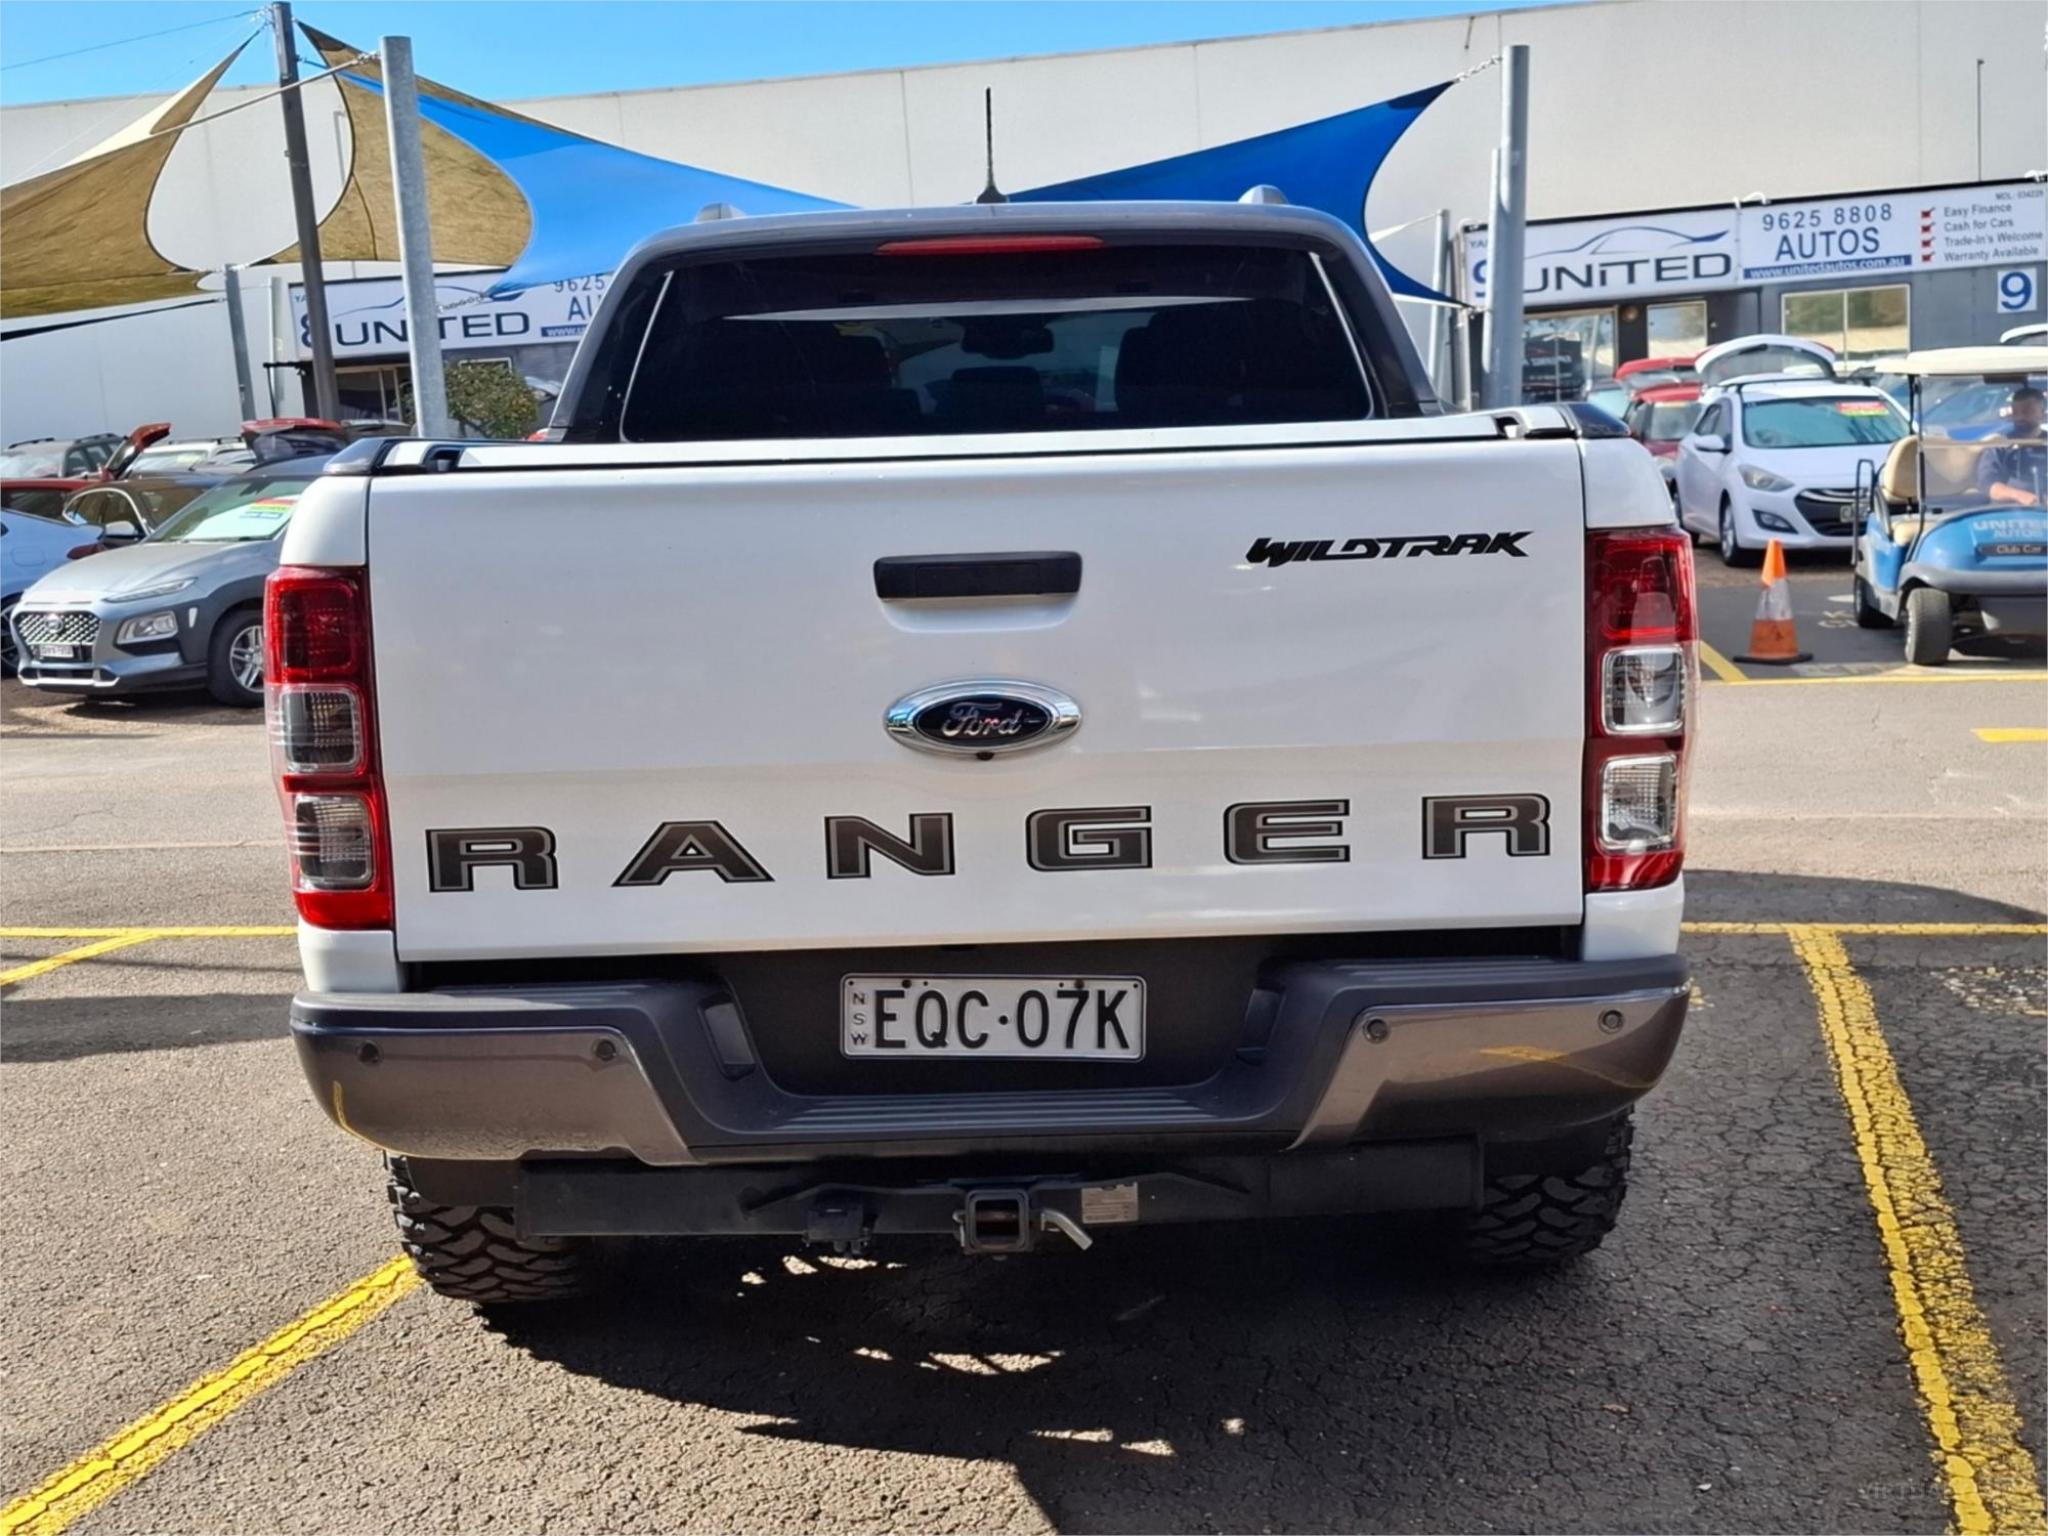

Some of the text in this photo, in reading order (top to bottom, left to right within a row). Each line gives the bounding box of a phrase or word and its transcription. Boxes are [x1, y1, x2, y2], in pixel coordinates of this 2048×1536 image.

[1762, 203, 1892, 231] 9625 8808
[1944, 202, 2012, 218] Easy Finance
[1944, 217, 2014, 232] Cash for Cars
[1775, 226, 1881, 262] AUTOS
[1997, 231, 2043, 243] Welcome
[1751, 257, 1905, 280] www.unitedautos.com.au
[1944, 246, 2039, 262] Warranty Available
[2001, 271, 2033, 310] 9
[335, 312, 531, 347] UNTED
[1246, 530, 1534, 567] WILDTRAK
[942, 702, 1026, 737] Ford
[425, 793, 1551, 893] RANGER
